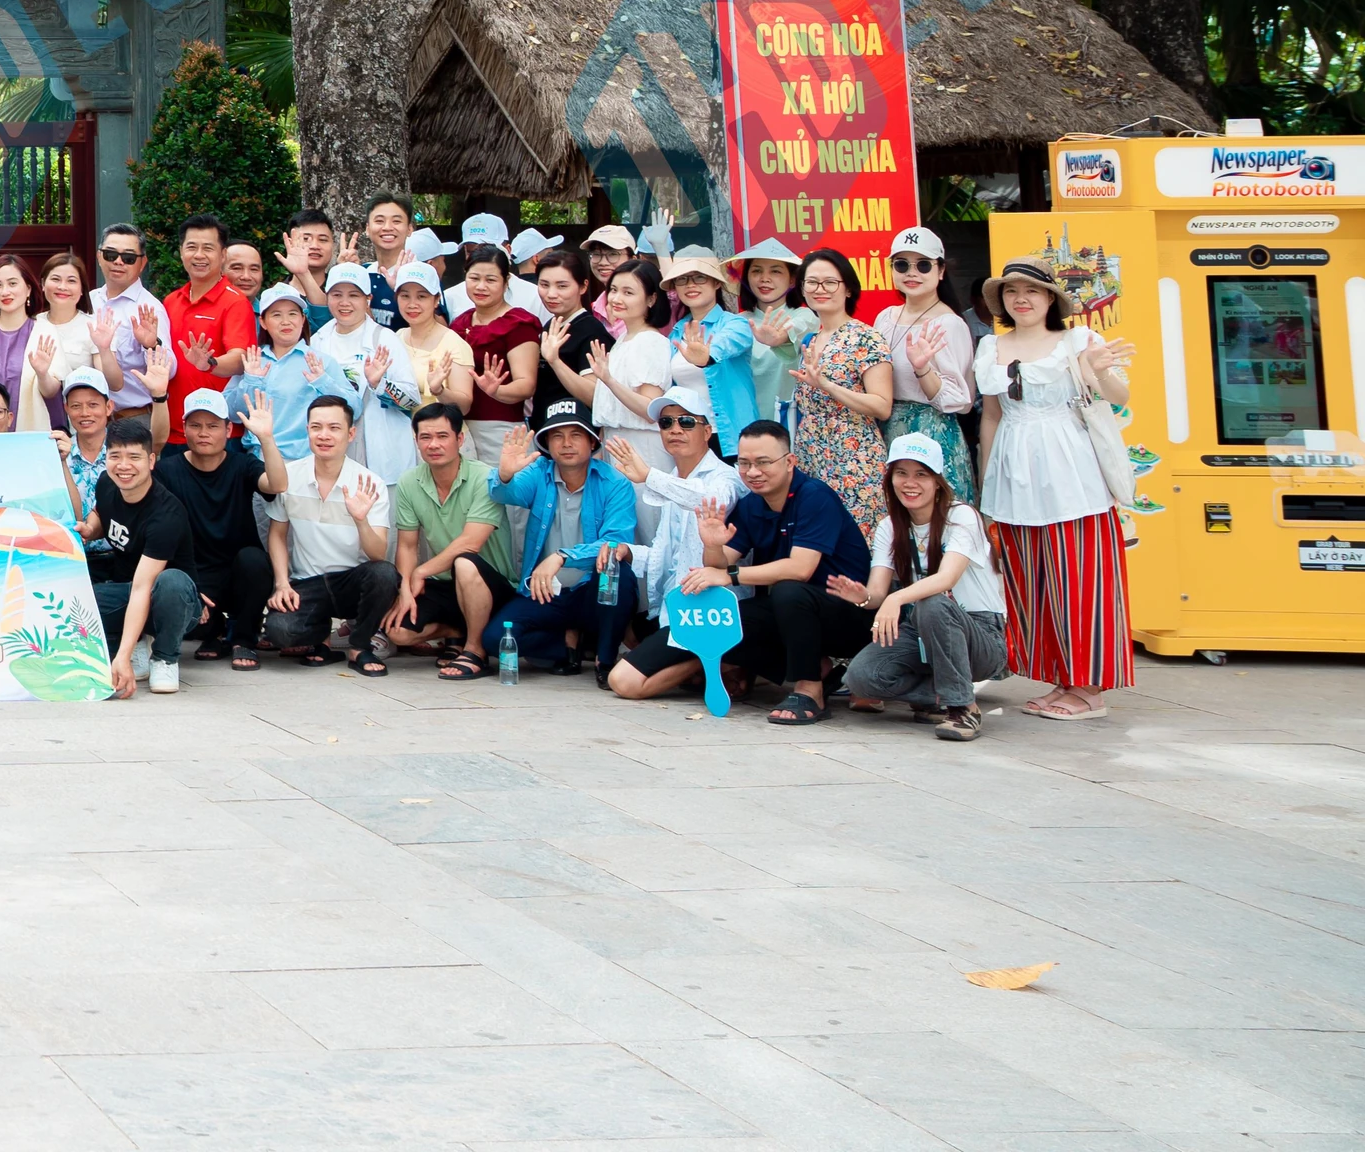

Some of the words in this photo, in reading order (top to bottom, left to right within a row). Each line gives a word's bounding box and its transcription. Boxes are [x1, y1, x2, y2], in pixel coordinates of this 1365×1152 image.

[756, 16, 825, 64] CỘNG
[832, 14, 884, 56] HÒA
[780, 74, 816, 115] XÃ
[822, 73, 865, 122] HỘI
[759, 128, 810, 175] CHỦ
[818, 133, 897, 174] NGHĨA
[1211, 147, 1306, 173] Newspaper
[1065, 152, 1103, 176] Newspaper
[1066, 183, 1115, 197] Photobooth
[1212, 181, 1335, 196] Photobooth
[771, 192, 824, 240] VIỆT
[831, 198, 892, 232] NAM
[1191, 221, 1256, 229] NEWSPAPER
[1260, 220, 1335, 228] PHOTOBOOTH
[546, 401, 576, 419] GUCCI
[907, 445, 928, 455] 2026
[1341, 551, 1363, 561] ĐÂY
[677, 608, 704, 626] XE
[707, 608, 734, 626] 03
